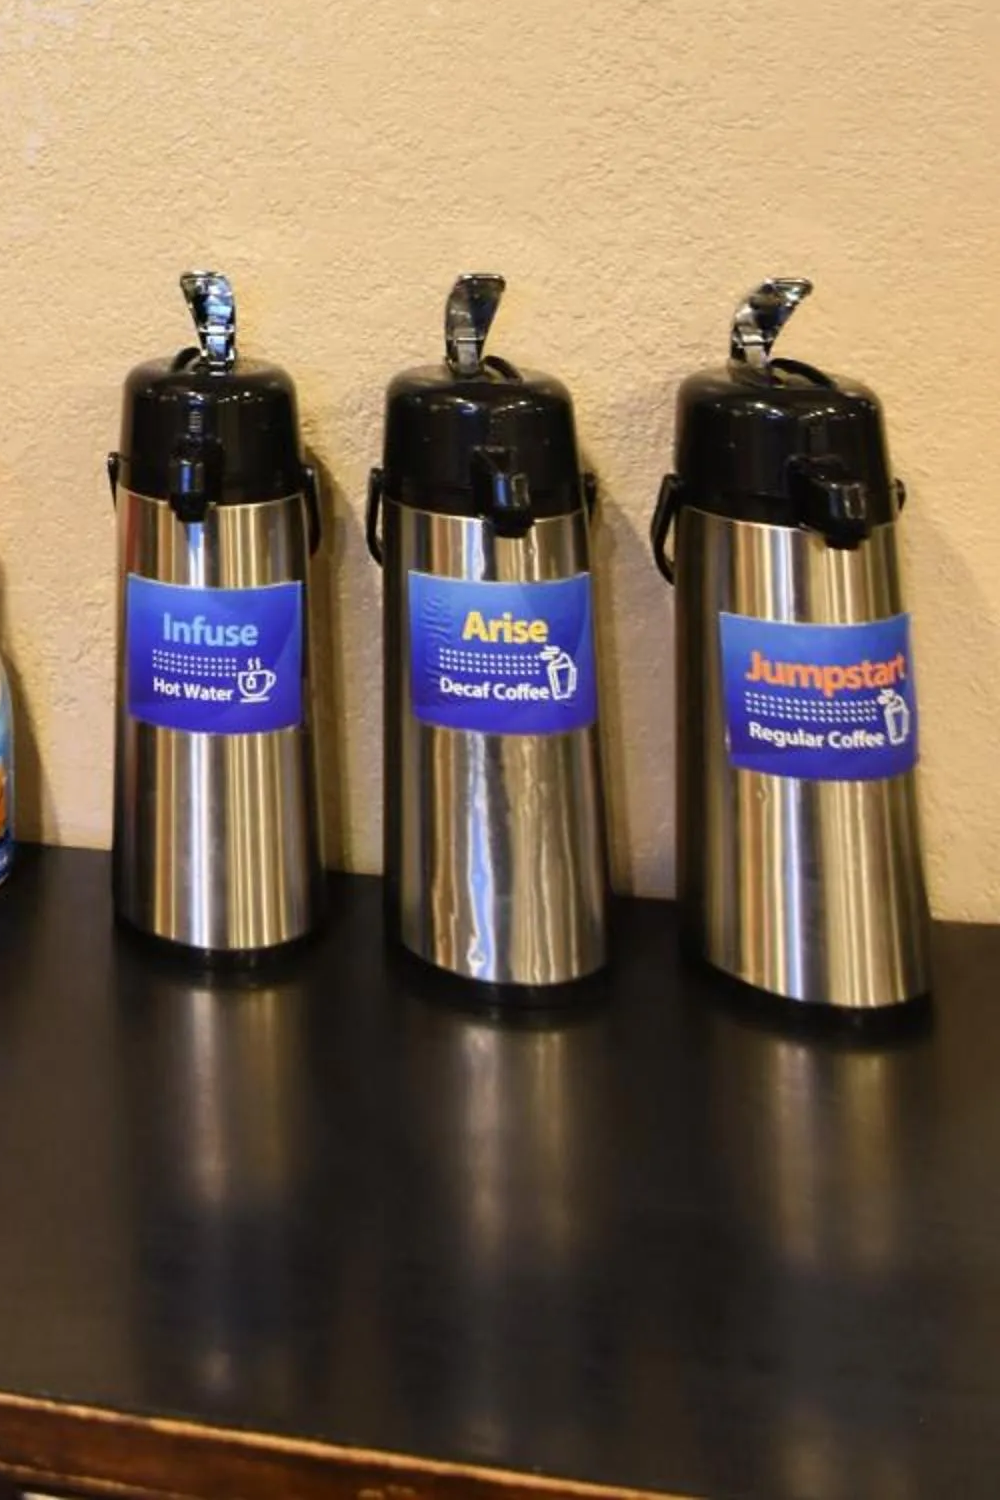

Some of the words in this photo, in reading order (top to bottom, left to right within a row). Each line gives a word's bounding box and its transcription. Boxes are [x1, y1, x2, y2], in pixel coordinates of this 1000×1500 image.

[162, 612, 259, 648] Infuse
[460, 611, 549, 645] Arise
[153, 675, 184, 699] Hot
[188, 681, 234, 703] Water
[439, 676, 490, 700] Decaf
[493, 678, 550, 701] Coffee
[744, 650, 906, 699] Jumpstart
[748, 721, 826, 749] Regular
[827, 728, 886, 749] Coffee
